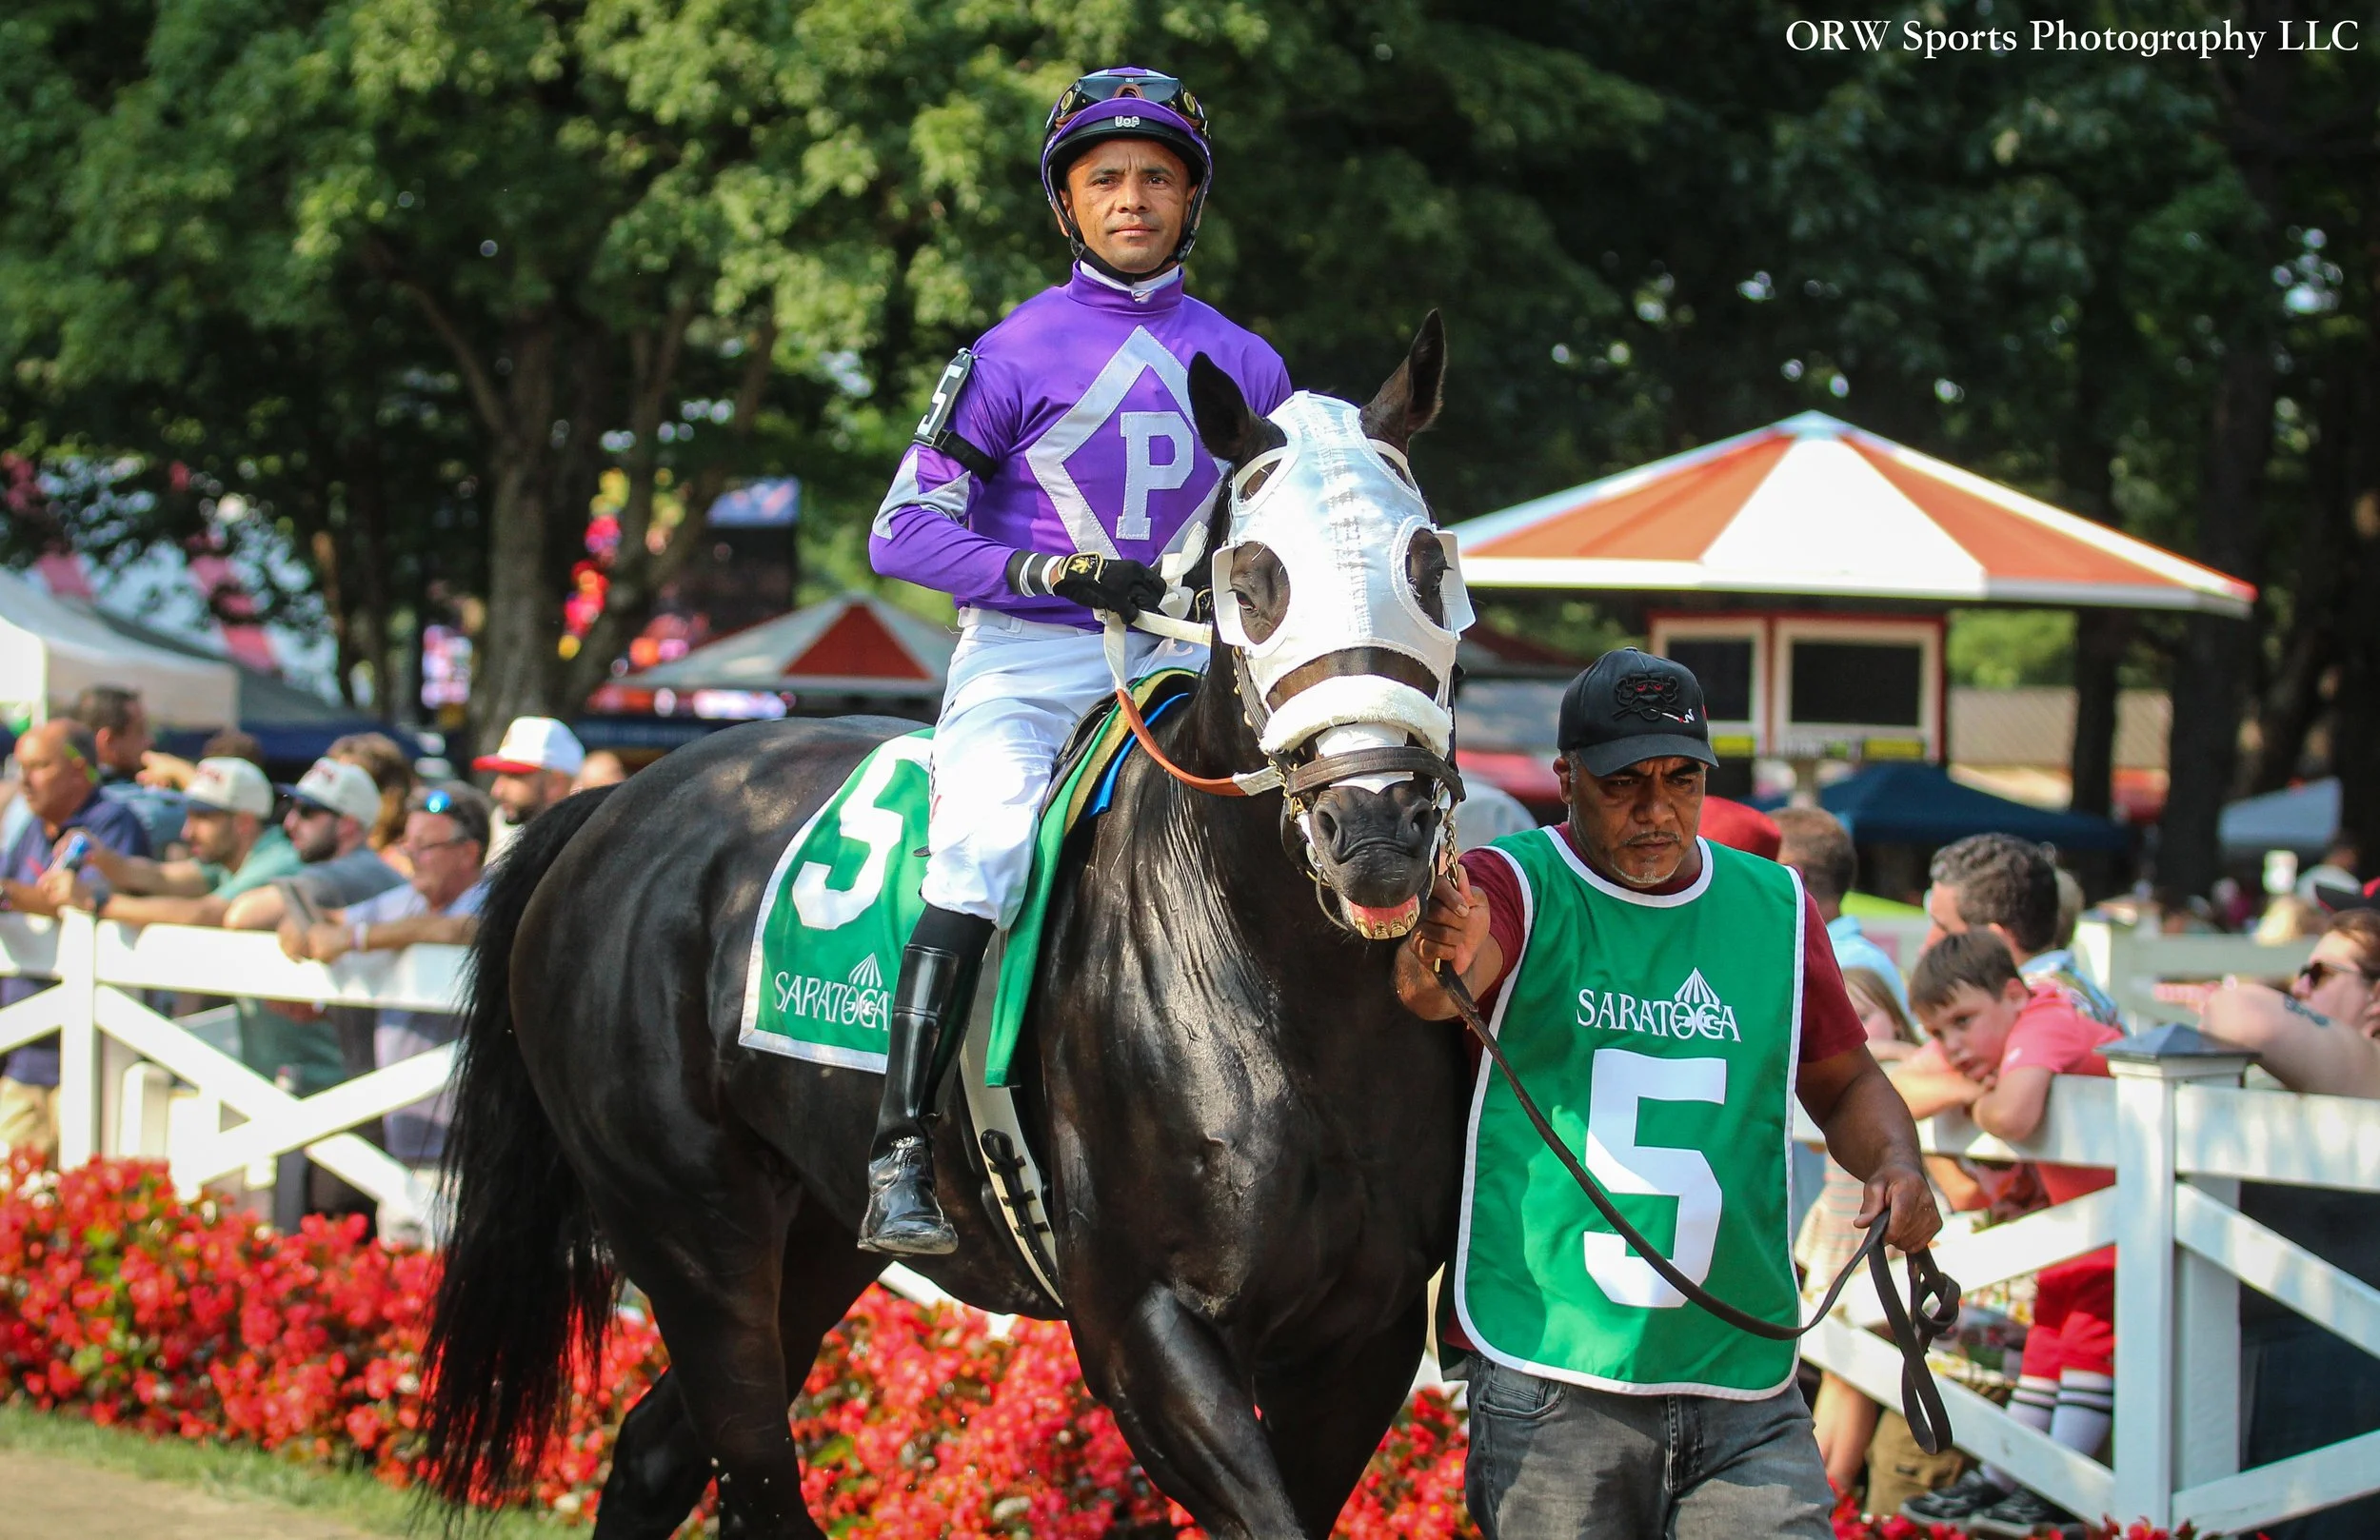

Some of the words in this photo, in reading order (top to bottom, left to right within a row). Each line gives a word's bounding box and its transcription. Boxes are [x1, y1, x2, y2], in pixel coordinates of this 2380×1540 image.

[917, 364, 963, 435] 5
[1116, 411, 1194, 541] P
[792, 735, 935, 921] 5
[774, 970, 892, 1032] SARATOGA
[1576, 988, 1742, 1043] SARATOGA
[1583, 1047, 1727, 1309] 5
